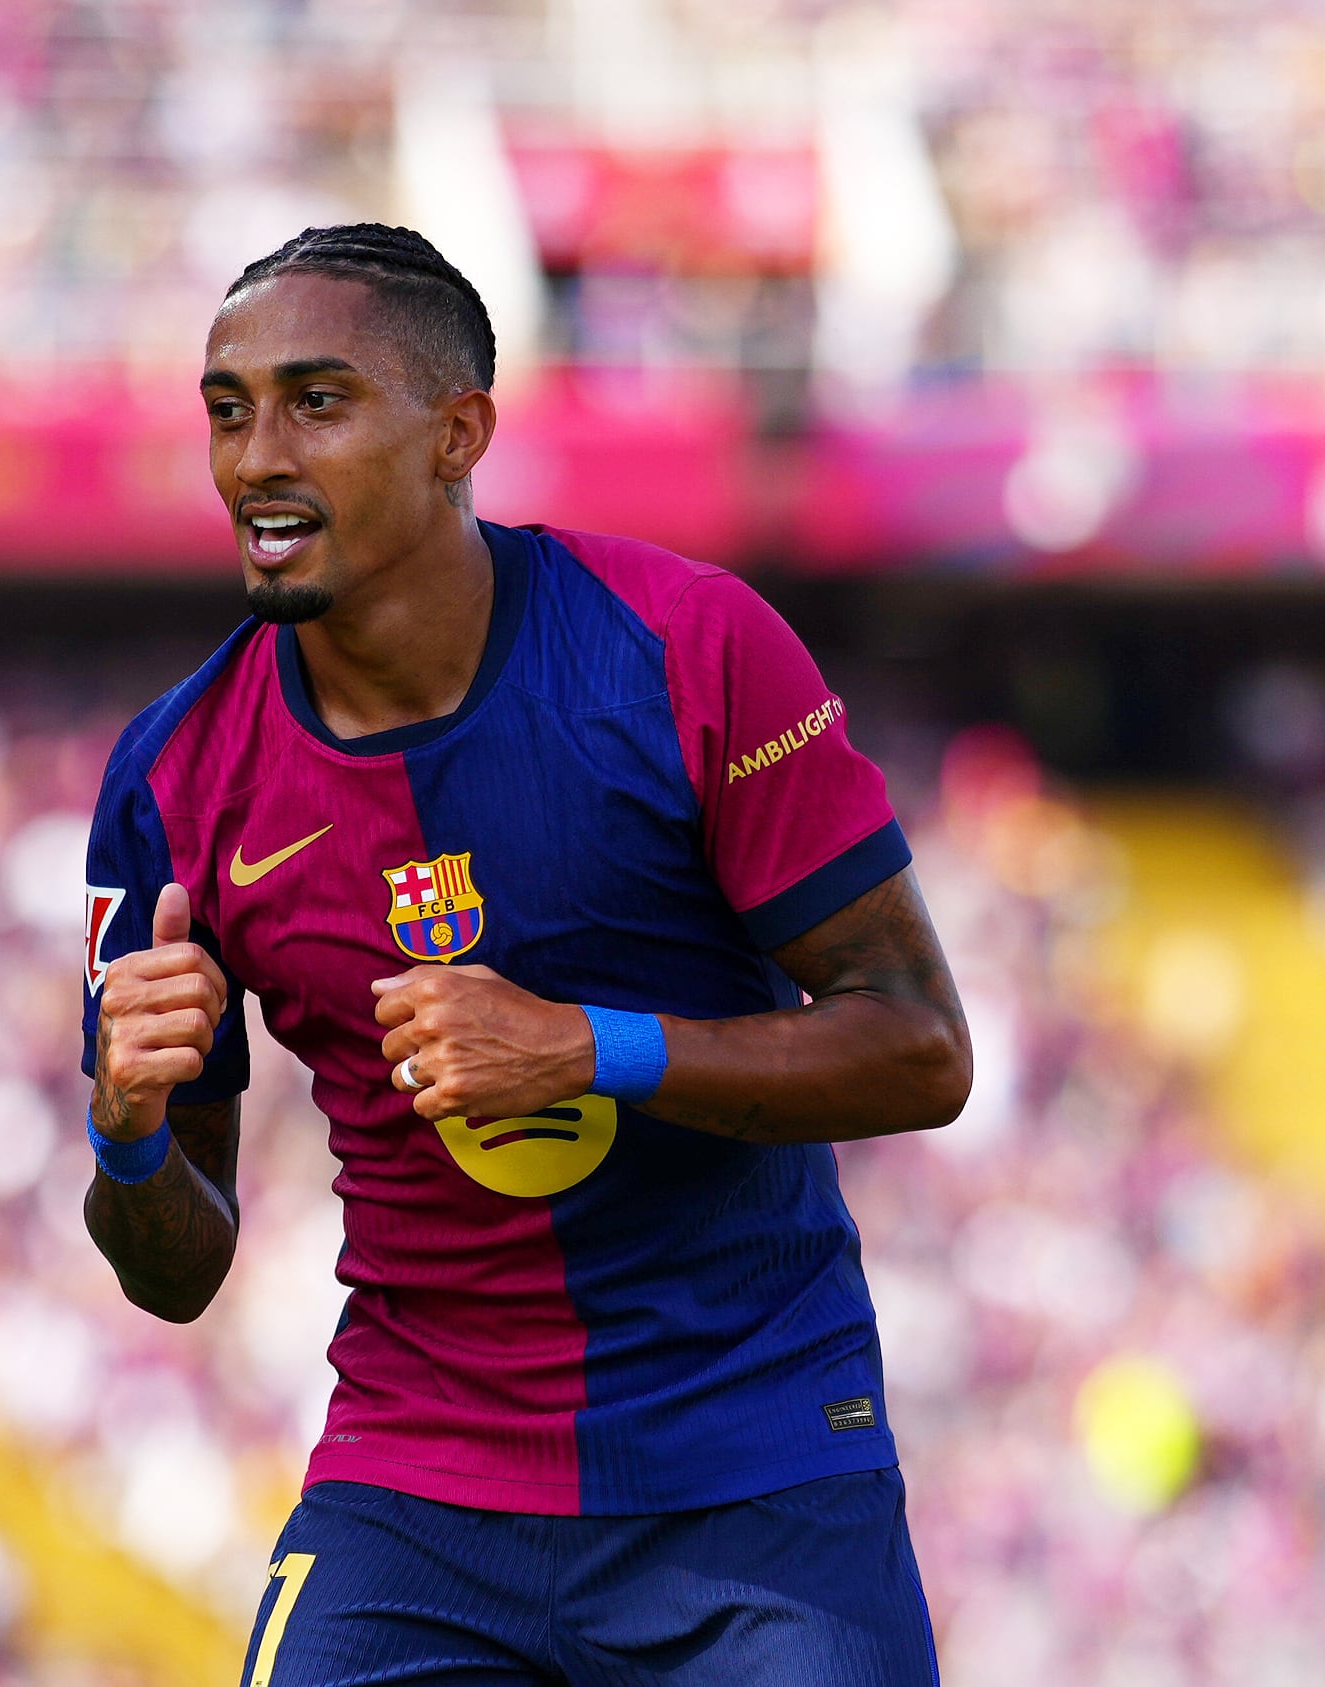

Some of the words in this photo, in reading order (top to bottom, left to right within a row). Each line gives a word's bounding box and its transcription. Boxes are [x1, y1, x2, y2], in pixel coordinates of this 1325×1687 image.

[728, 699, 834, 785] AMBILIGHT
[418, 899, 455, 918] FCB
[249, 1552, 317, 1687] 1
